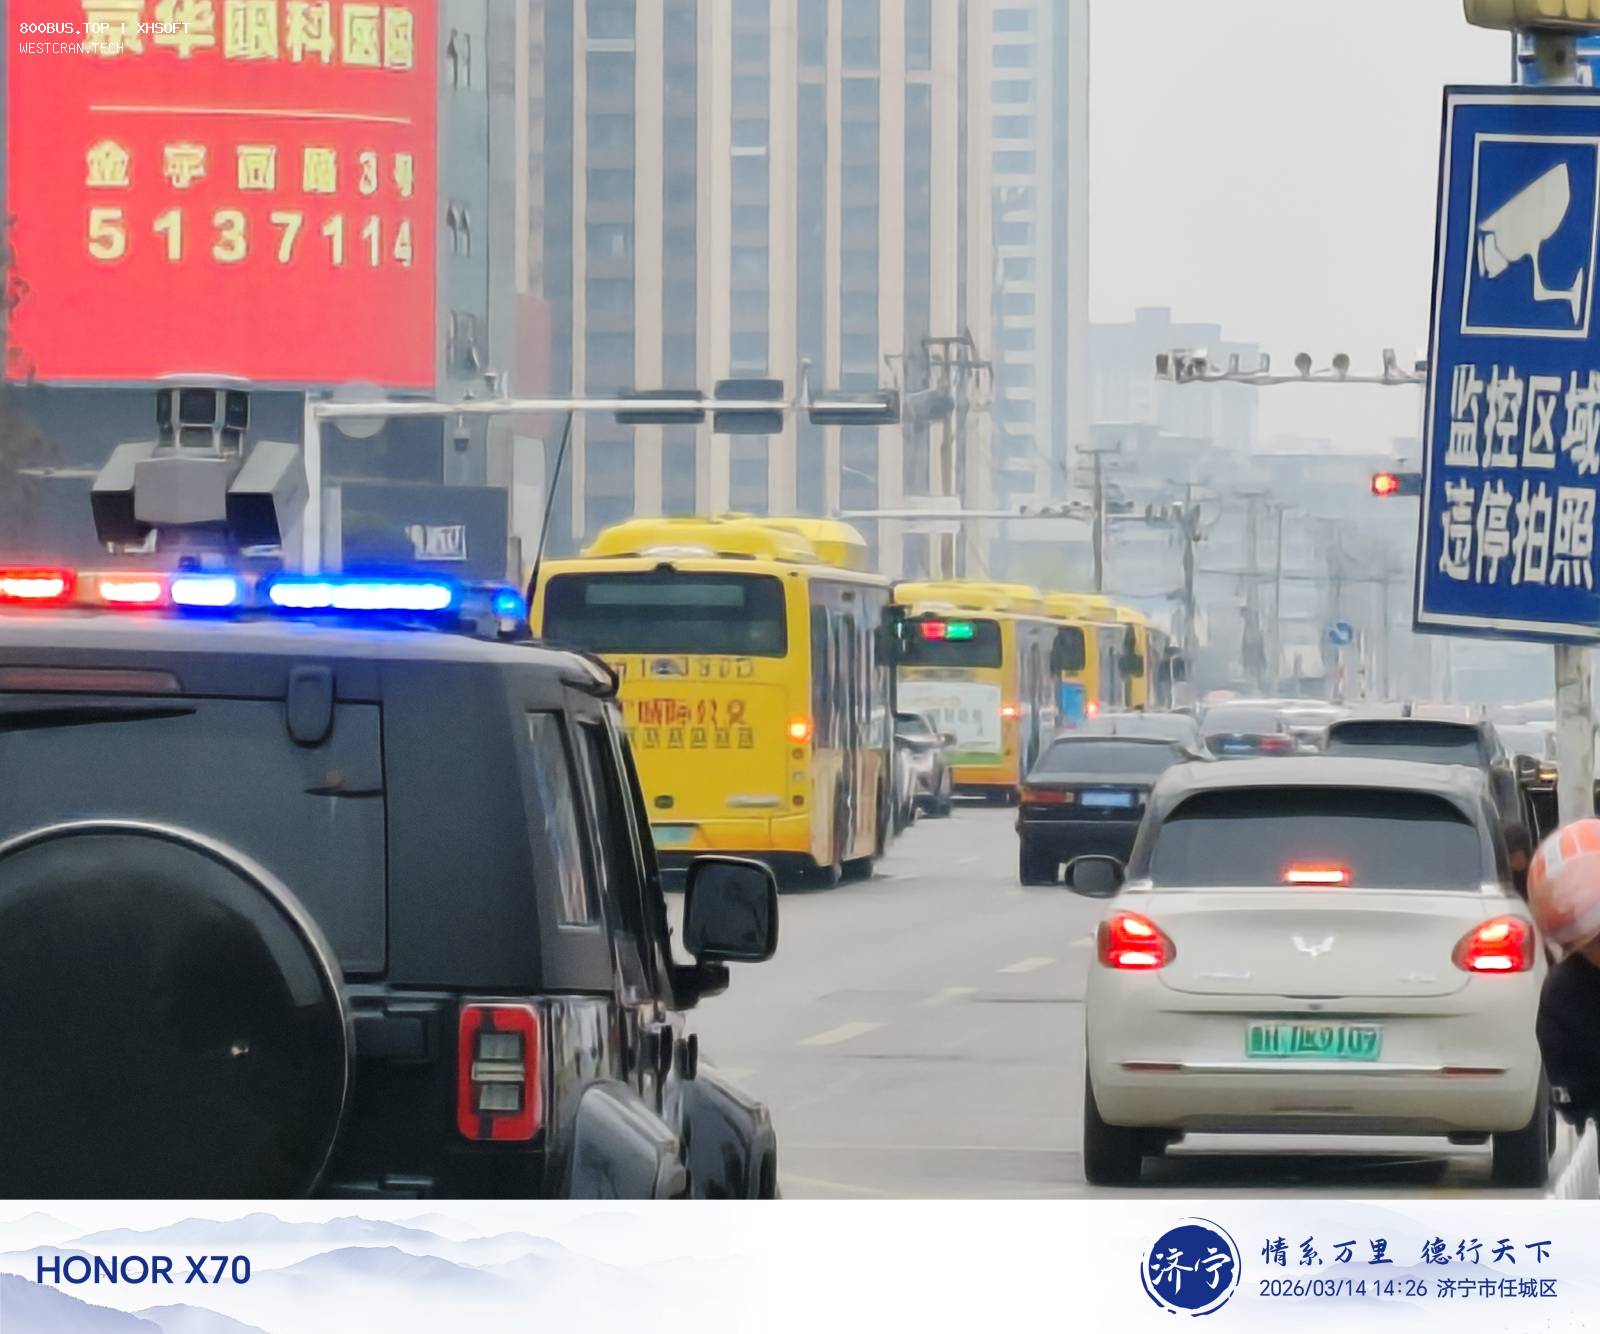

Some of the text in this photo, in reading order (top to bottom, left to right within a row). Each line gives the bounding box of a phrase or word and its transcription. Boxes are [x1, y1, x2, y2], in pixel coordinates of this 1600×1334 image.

[88, 207, 413, 268] 5137114
[1445, 364, 1600, 475] 监控区域
[1439, 477, 1597, 590] 违停拍照
